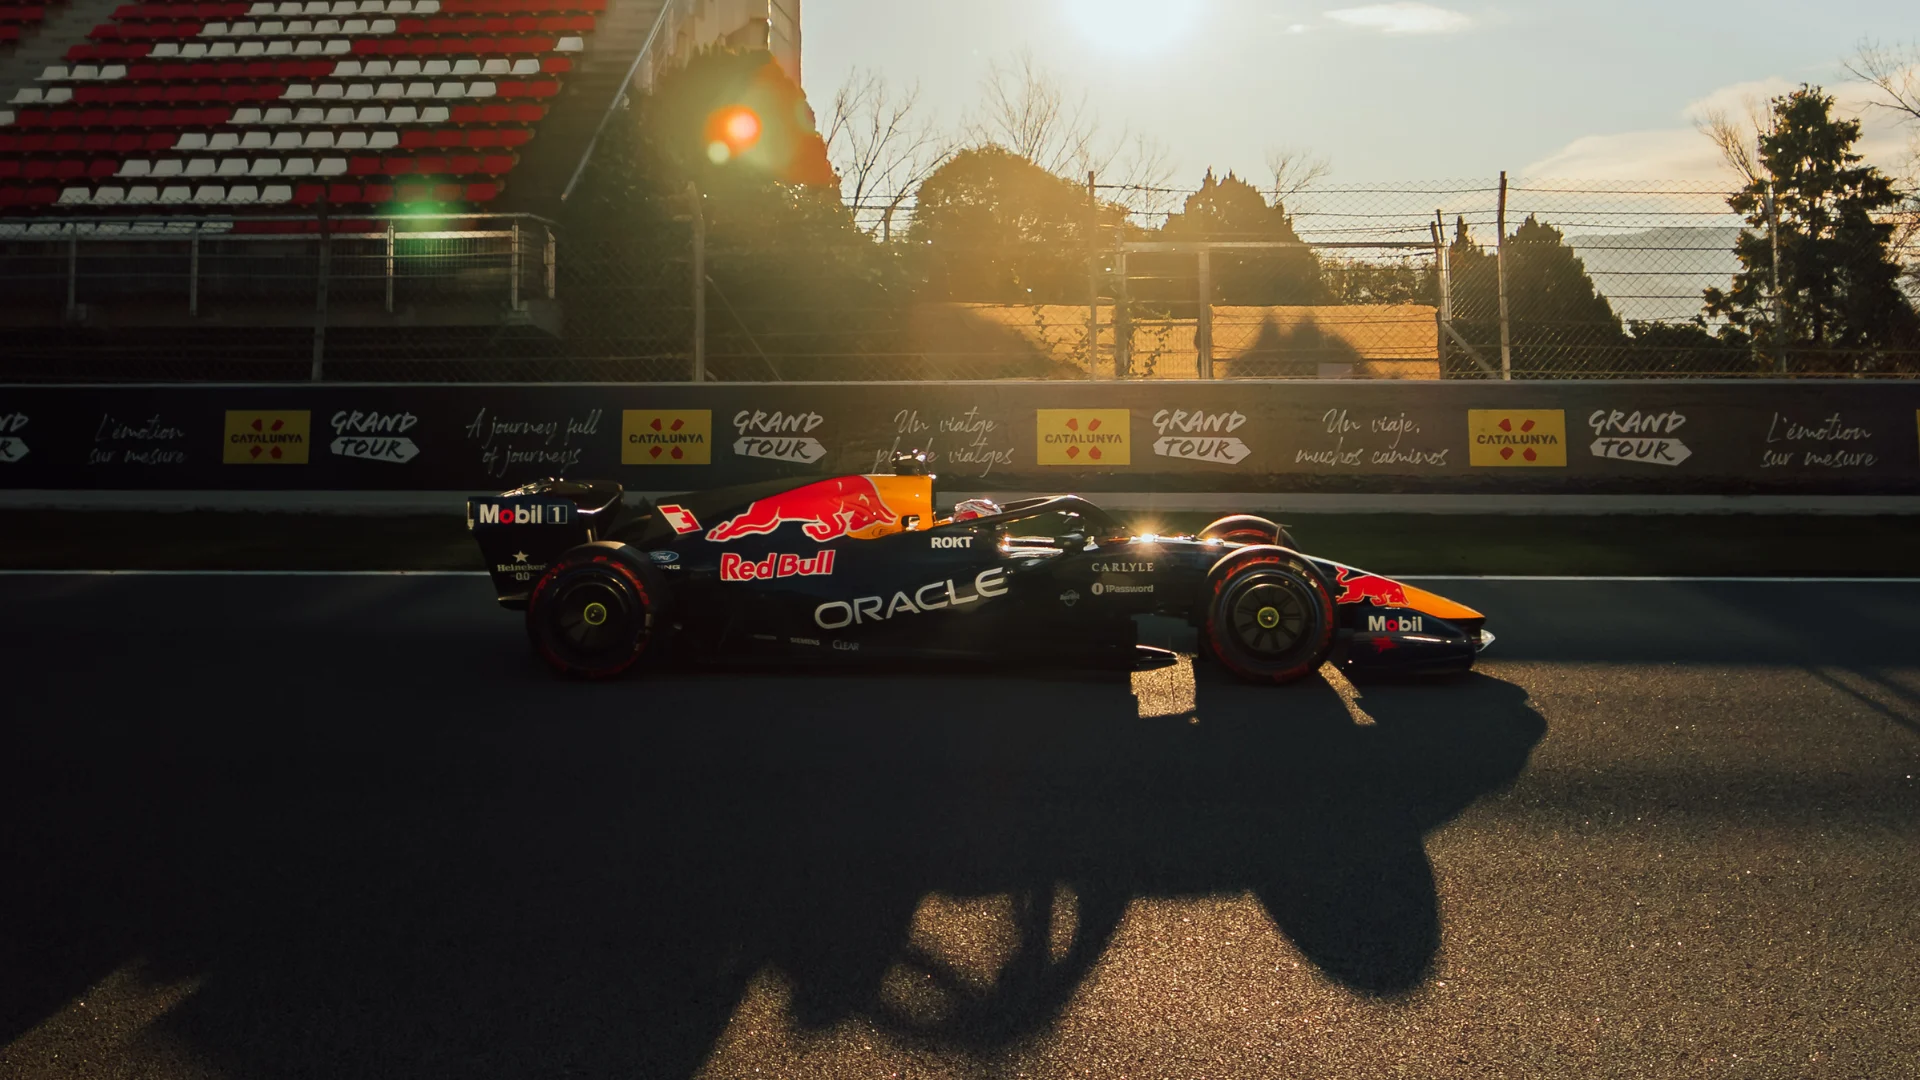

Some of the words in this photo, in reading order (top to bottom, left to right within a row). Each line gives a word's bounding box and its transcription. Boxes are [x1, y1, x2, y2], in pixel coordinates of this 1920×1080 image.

[331, 410, 417, 434] GRAND
[466, 408, 485, 439] A
[487, 416, 558, 449] journey
[733, 409, 823, 434] GRAND
[894, 409, 929, 434] Un
[939, 406, 999, 447] viatge
[1152, 409, 1247, 433] GRAND
[1322, 408, 1361, 433] Un
[1588, 409, 1687, 434] GRAND
[231, 434, 302, 444] CATALUNYA
[341, 438, 404, 459] TOUR
[629, 434, 703, 444] CATALUNYA
[744, 438, 808, 459] TOUR
[1045, 433, 1122, 444] CATALUNYA
[1164, 438, 1233, 459] TOUR
[1477, 434, 1558, 444] CATALUNYA
[124, 450, 186, 465] mesure
[949, 437, 1015, 478] viatges
[1295, 437, 1364, 465] muchos
[1371, 446, 1450, 465] caminos
[1600, 438, 1675, 461] TOUR
[1760, 449, 1795, 468] sur
[1804, 451, 1879, 468] mesure
[496, 445, 581, 478] journeys
[479, 504, 542, 524] Mobil
[931, 536, 974, 548] ROKT
[650, 553, 674, 563] Ford
[720, 553, 776, 581] Red
[776, 550, 836, 578] Bull
[1091, 562, 1154, 572] CARLYLE
[814, 567, 1009, 630] ORACLE
[1105, 584, 1154, 593] 1Password
[1368, 614, 1423, 632] Mobil
